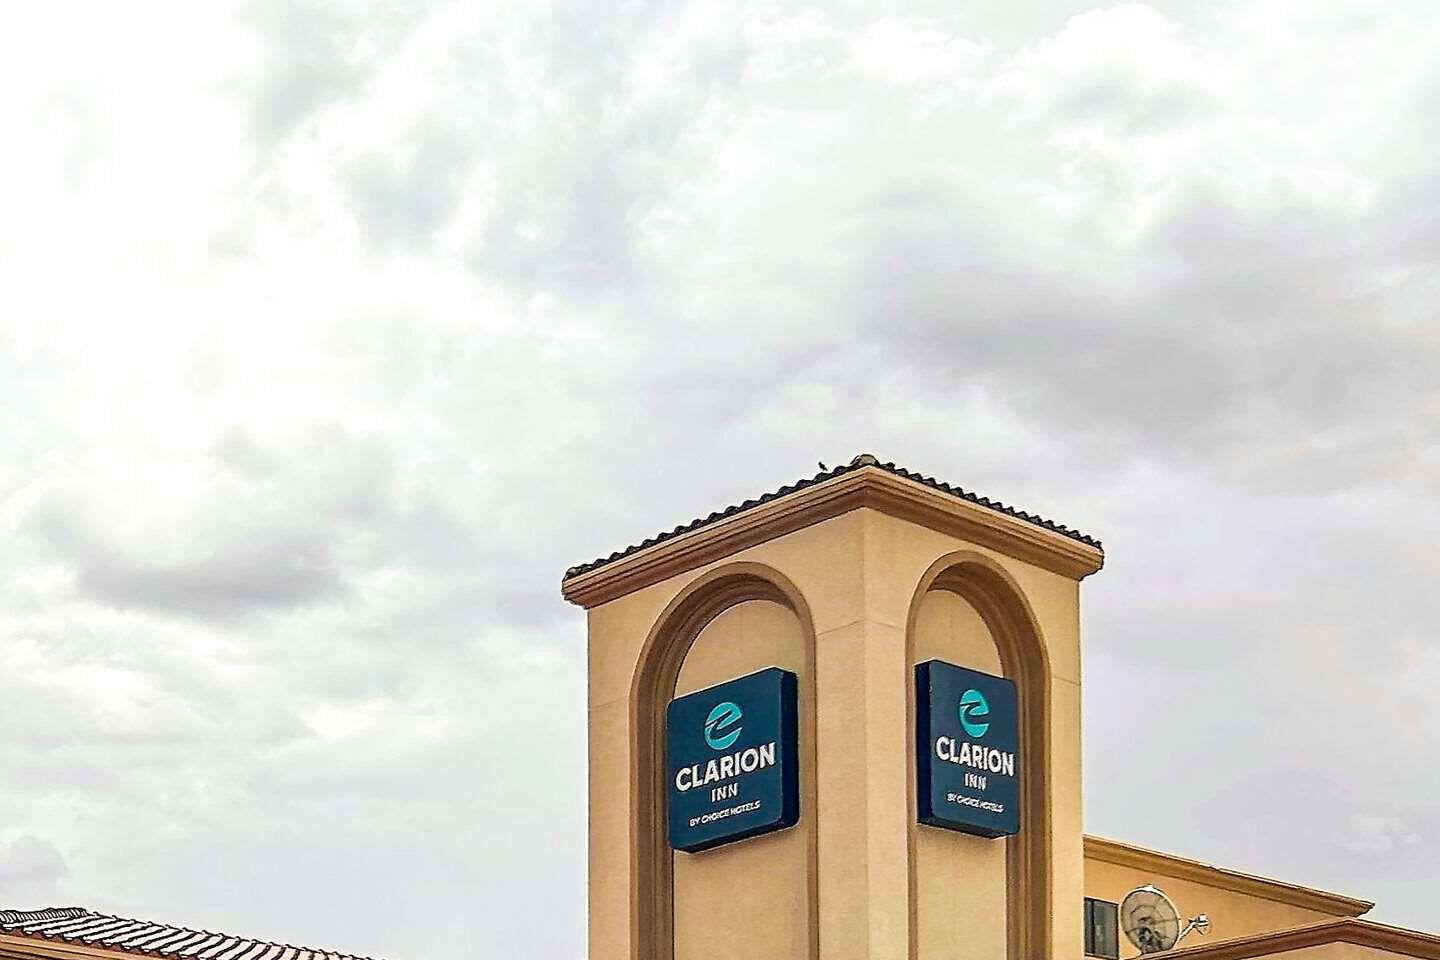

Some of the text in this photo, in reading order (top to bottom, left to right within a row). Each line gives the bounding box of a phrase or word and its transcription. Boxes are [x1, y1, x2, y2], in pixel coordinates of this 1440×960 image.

[675, 741, 776, 792] CLARION
[935, 736, 1015, 777] CLARION
[711, 783, 738, 803] INN
[964, 773, 987, 791] INN
[689, 800, 761, 827] BY CHOICE HOTELS
